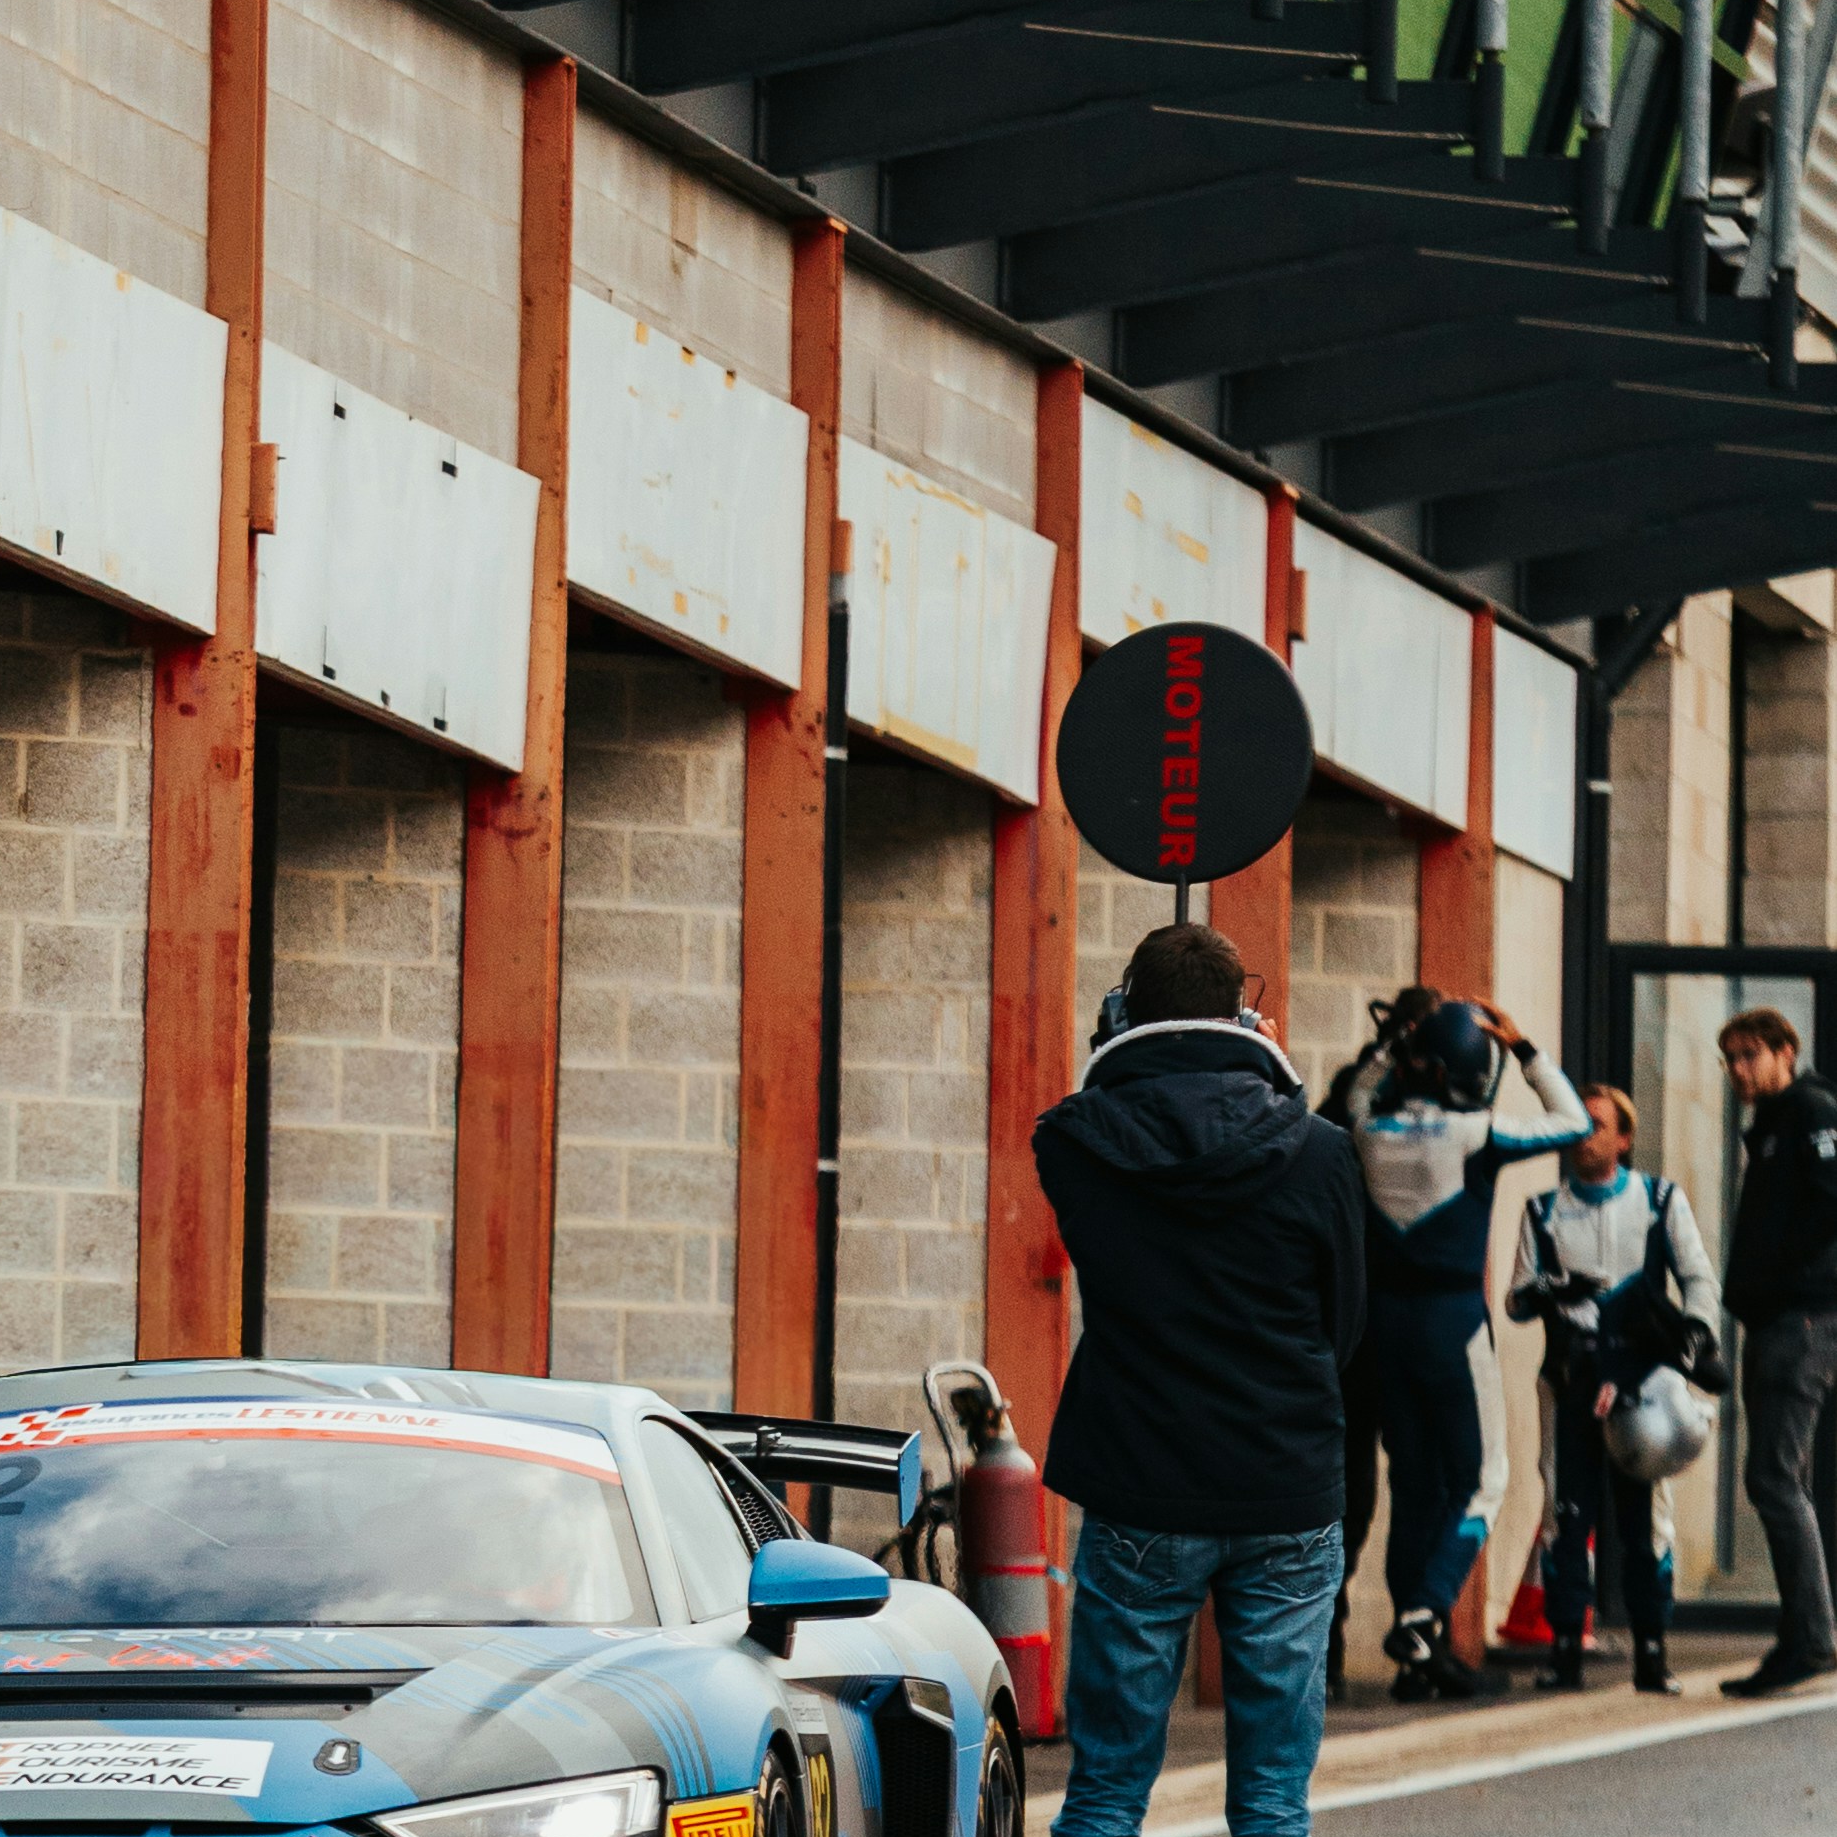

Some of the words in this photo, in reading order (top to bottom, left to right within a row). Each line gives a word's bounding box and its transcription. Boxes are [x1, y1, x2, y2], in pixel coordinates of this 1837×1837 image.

[1158, 636, 1204, 867] MOTEUR
[236, 1408, 452, 1428] LESTIENNE
[115, 1628, 354, 1643] SPORT
